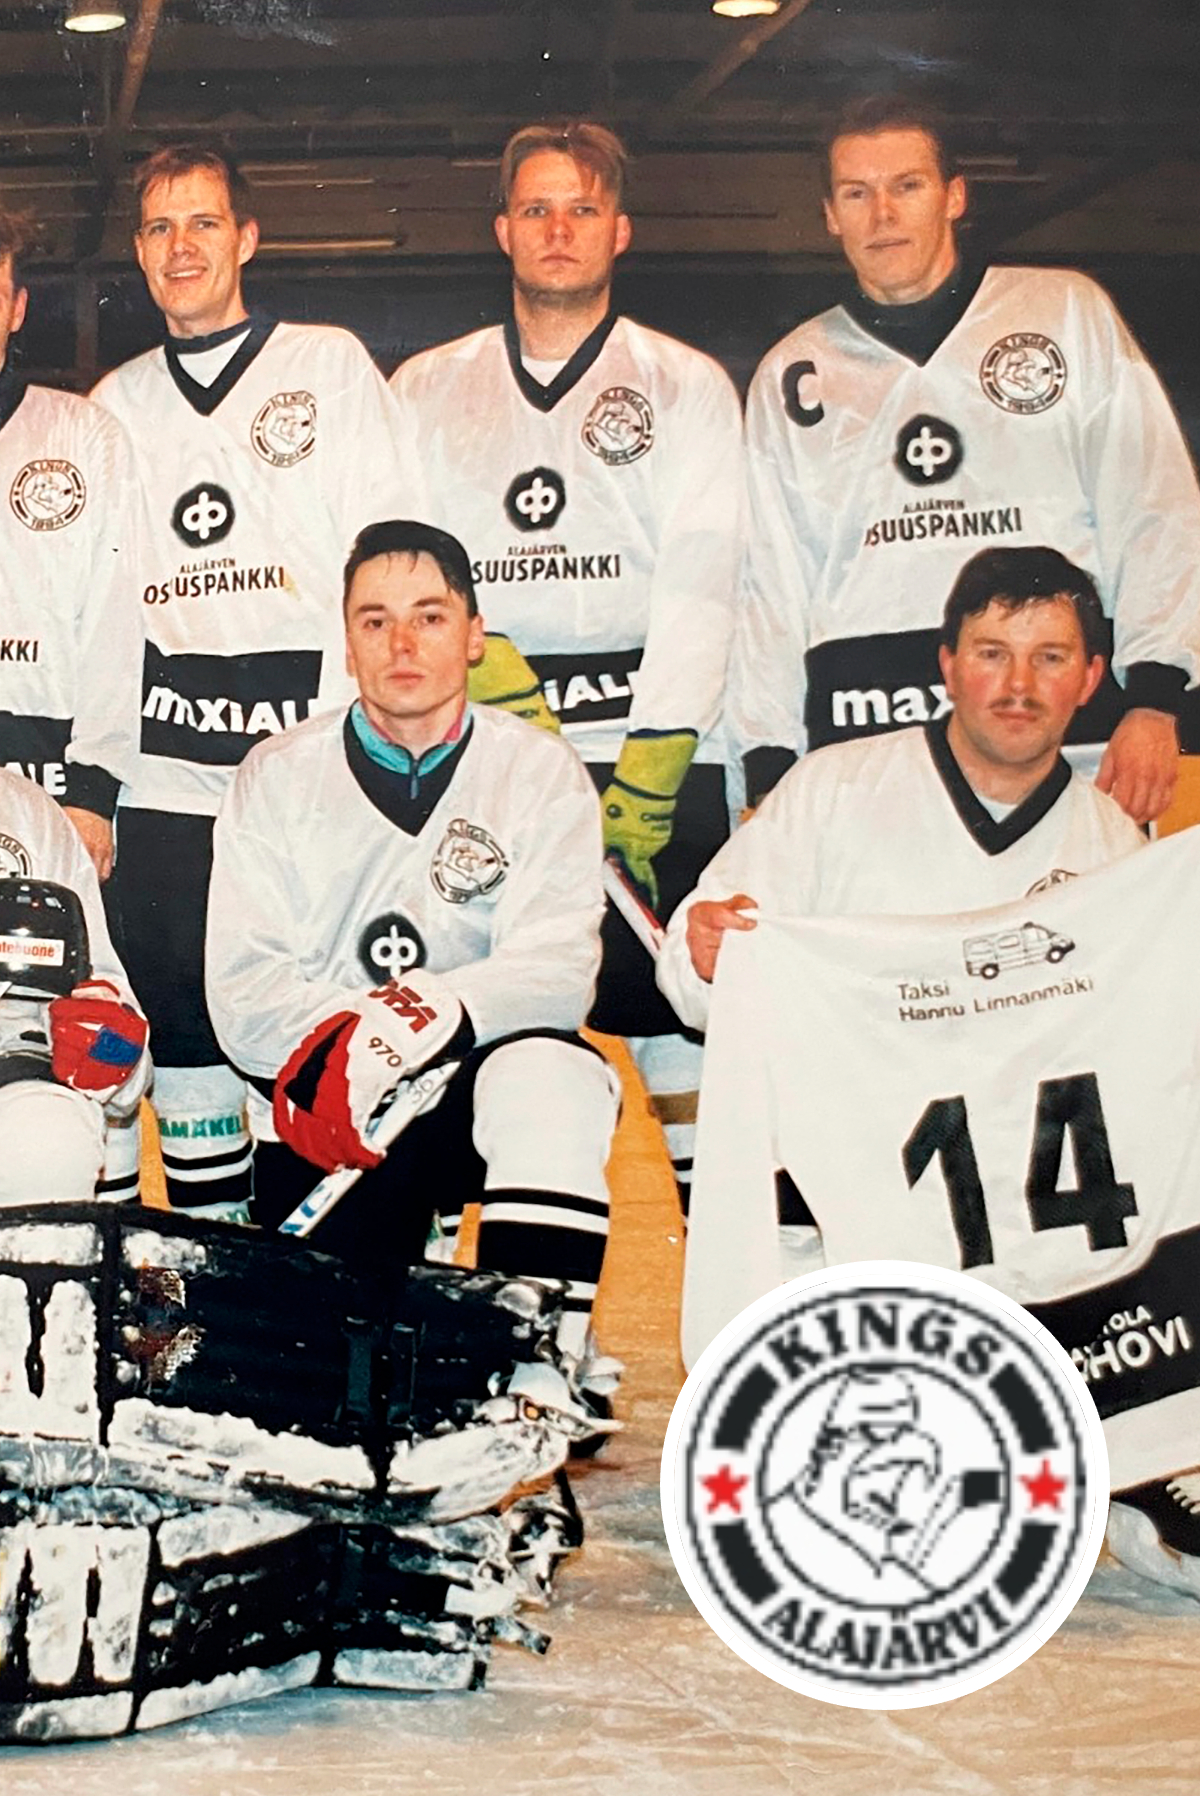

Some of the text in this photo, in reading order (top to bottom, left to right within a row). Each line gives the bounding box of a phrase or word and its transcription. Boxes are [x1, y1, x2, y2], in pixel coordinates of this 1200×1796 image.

[781, 360, 824, 428] C
[471, 554, 621, 585] SUUSPANKKI
[831, 684, 956, 727] max
[898, 981, 950, 1001] Taksi
[899, 976, 1095, 1022] Hannu Linnanmäki
[368, 1036, 403, 1068] 970
[901, 1072, 1140, 1272] 14
